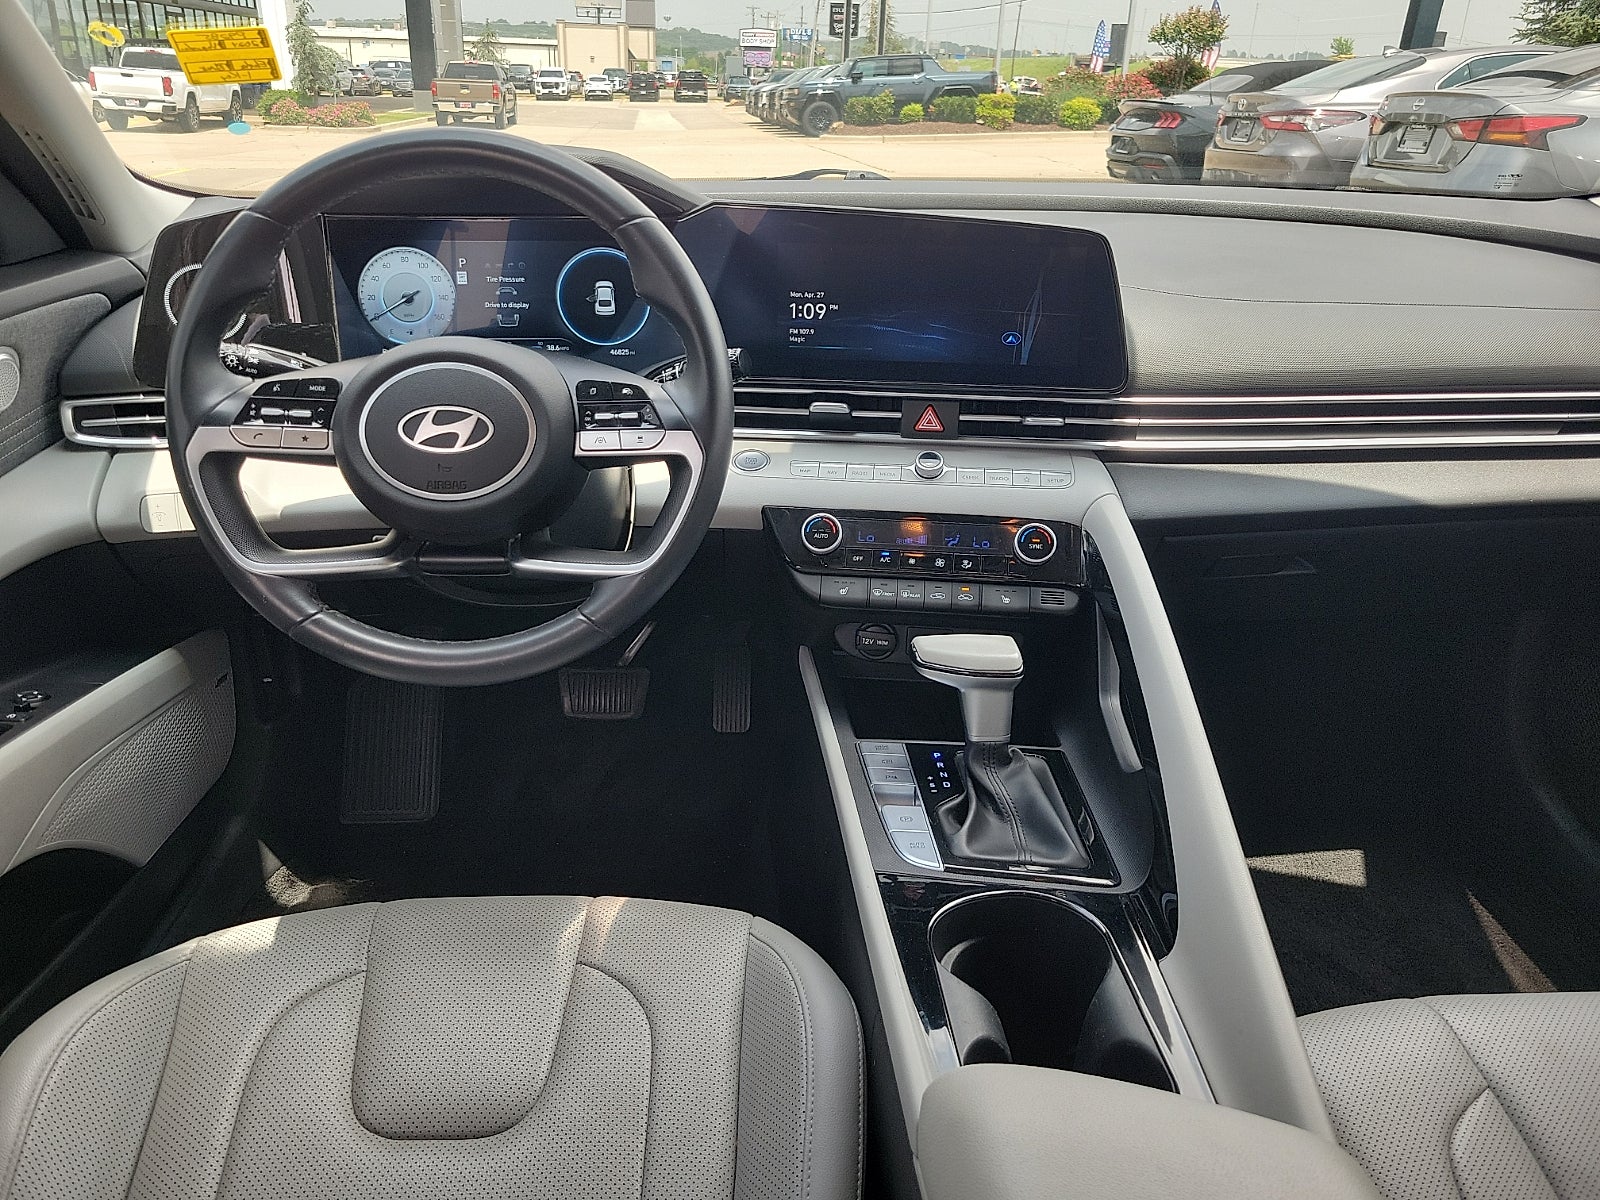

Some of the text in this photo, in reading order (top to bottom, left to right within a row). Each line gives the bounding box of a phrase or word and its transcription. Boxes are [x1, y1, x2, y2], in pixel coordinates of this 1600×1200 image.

[458, 258, 467, 268] P
[508, 301, 530, 309] display
[790, 302, 827, 320] 1:09
[789, 335, 806, 343] Magic
[426, 480, 468, 490] AIRBAG
[862, 637, 875, 645] 12V
